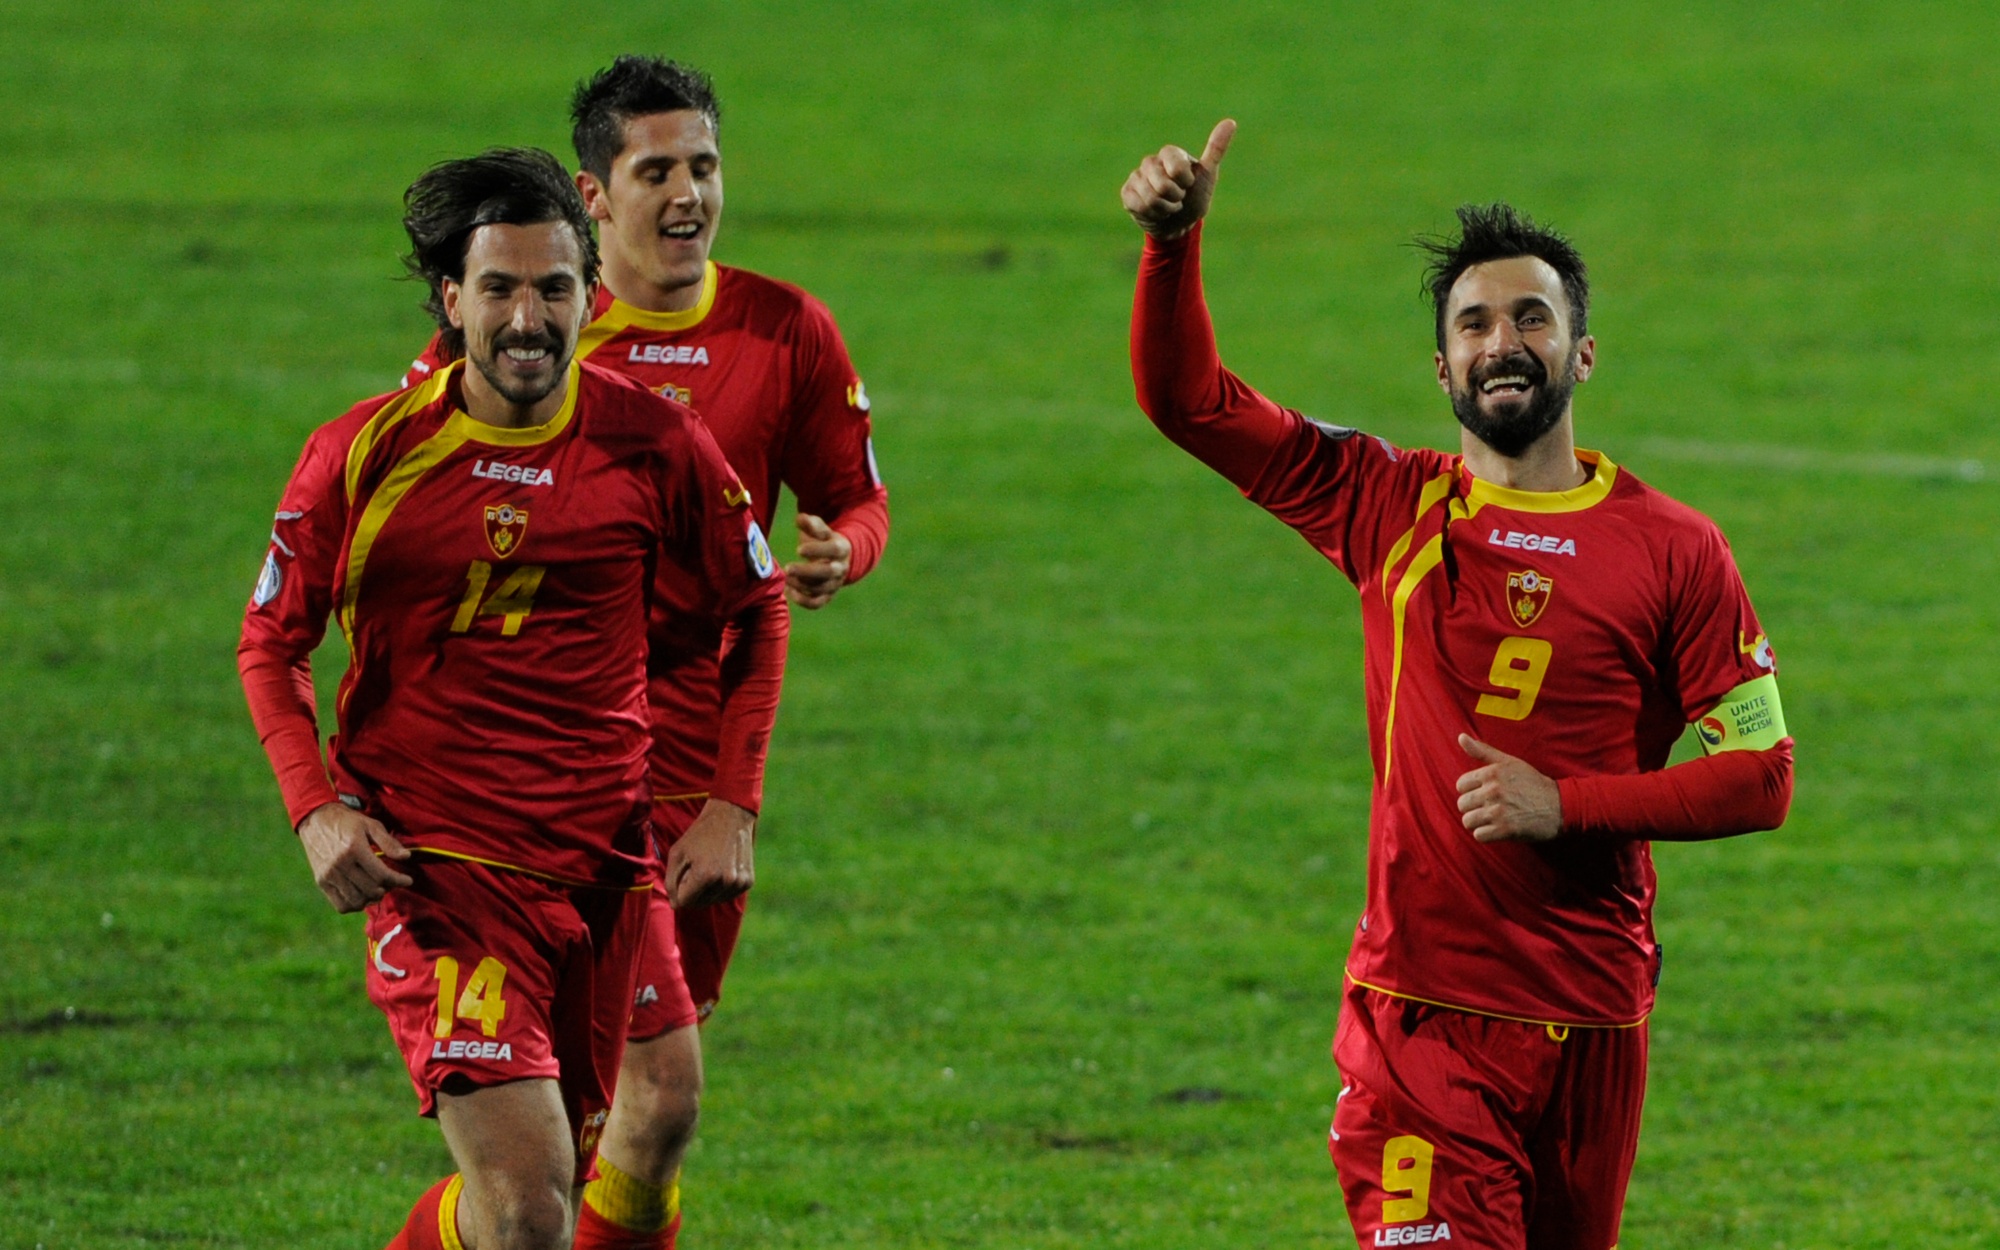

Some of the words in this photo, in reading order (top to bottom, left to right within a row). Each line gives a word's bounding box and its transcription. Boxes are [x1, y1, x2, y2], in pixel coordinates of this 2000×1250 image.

[628, 344, 709, 365] LEGEA
[472, 459, 554, 485] LEGEA
[1488, 528, 1576, 556] LEGEA
[450, 559, 547, 636] 14
[1475, 636, 1553, 721] 9
[1730, 695, 1767, 717] UNITE
[1736, 708, 1770, 727] AGAINST
[1738, 718, 1773, 737] RACISM
[434, 955, 507, 1039] 14
[431, 1040, 513, 1062] LEGEA
[1382, 1134, 1435, 1224] 9
[1374, 1222, 1451, 1247] LEGEA
